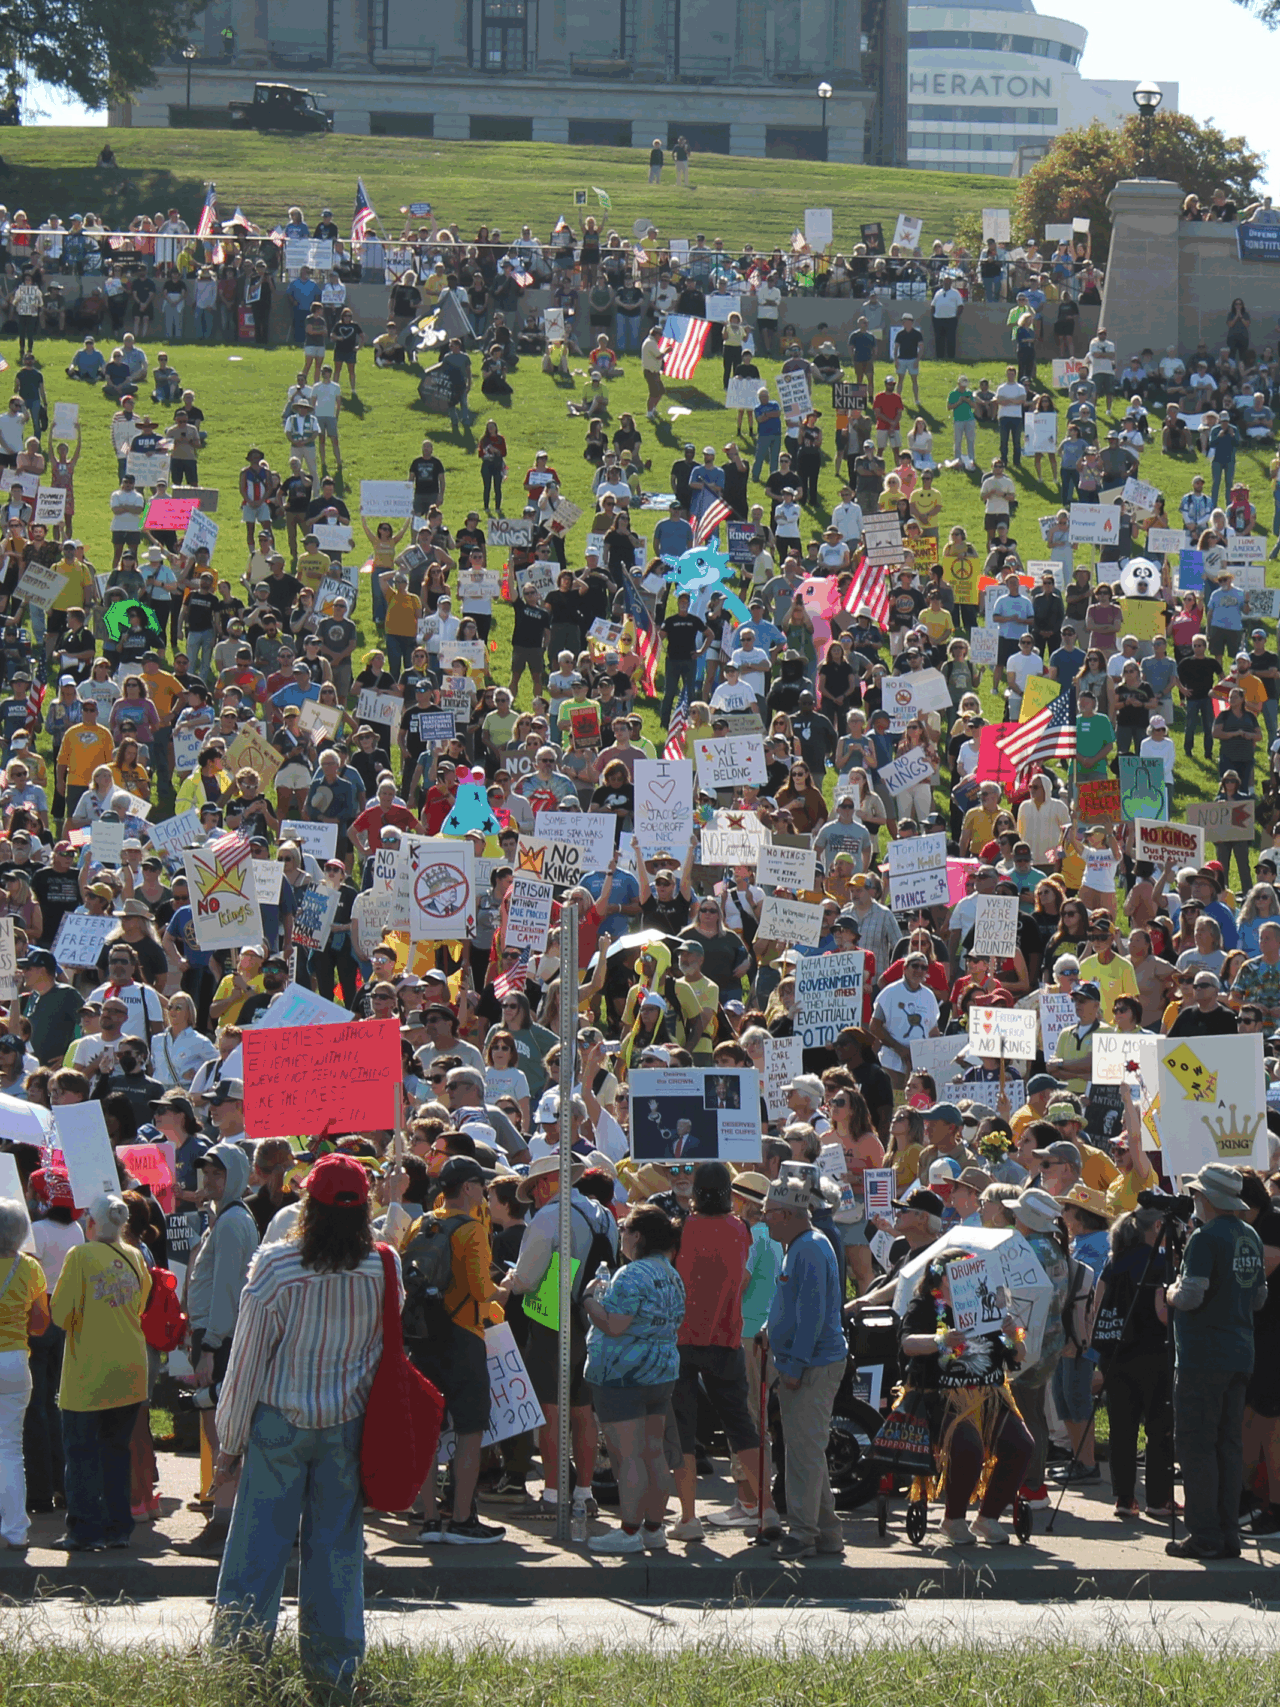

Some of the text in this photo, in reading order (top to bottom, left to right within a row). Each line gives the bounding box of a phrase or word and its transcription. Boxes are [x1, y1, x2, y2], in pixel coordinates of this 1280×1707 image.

[910, 73, 1050, 97] HERATON
[490, 521, 509, 531] NO
[322, 581, 335, 592] NO
[714, 742, 738, 756] WE
[505, 757, 532, 774] NO
[718, 756, 739, 768] ALL
[893, 756, 910, 771] NO
[656, 763, 671, 778] I
[713, 767, 751, 781] BELONG
[885, 756, 929, 792] KINGS
[543, 814, 583, 826] SOME OF
[154, 814, 193, 842] FIGHT
[1140, 826, 1198, 851] NO KINGS
[377, 851, 395, 866] NO
[409, 845, 422, 859] K
[551, 844, 579, 865] NO
[544, 861, 581, 886] KINGS
[514, 881, 551, 899] PRISON
[511, 897, 539, 909] WITHOUT
[894, 890, 927, 908] PRINCE
[197, 897, 221, 916] NO
[510, 906, 548, 919] DUE PROCESS
[768, 902, 779, 915] A
[218, 903, 255, 929] kings
[980, 908, 1011, 919] HERE
[68, 916, 114, 927] VETERA
[977, 919, 1016, 931] FOR THE
[769, 925, 819, 946] Resistance!
[976, 931, 1015, 940] LOVE OF
[974, 941, 1015, 954] COUNTRY
[801, 953, 854, 970] WHATEVER
[802, 965, 857, 979] YOU ALLOW YOUR
[798, 973, 862, 993] GOVERNMENT
[834, 988, 857, 998] OTHERS
[1042, 995, 1068, 1004] HATE
[805, 999, 847, 1010] THEY WILL
[1046, 1004, 1073, 1013] WILL
[797, 1008, 858, 1026] EVENTUALLY
[972, 1009, 980, 1021] I
[1055, 1014, 1074, 1022] NOT
[817, 1026, 834, 1045] TO
[972, 1023, 980, 1035] I
[772, 1038, 793, 1048] HEALTH
[979, 1039, 1032, 1055] NO KINGS
[1097, 1037, 1117, 1053] NO
[771, 1052, 790, 1061] CARE
[771, 1063, 786, 1072] IS A
[768, 1073, 788, 1082] HUMAN
[1217, 1099, 1226, 1109] A
[129, 1155, 157, 1171] SMALL
[774, 1187, 789, 1196] NO
[170, 1216, 188, 1227] NAZI
[172, 1240, 189, 1252] LIAR
[958, 1312, 978, 1329] ASS!
[938, 1374, 980, 1387] SINCE
[874, 1438, 930, 1454] SUPPORTER
